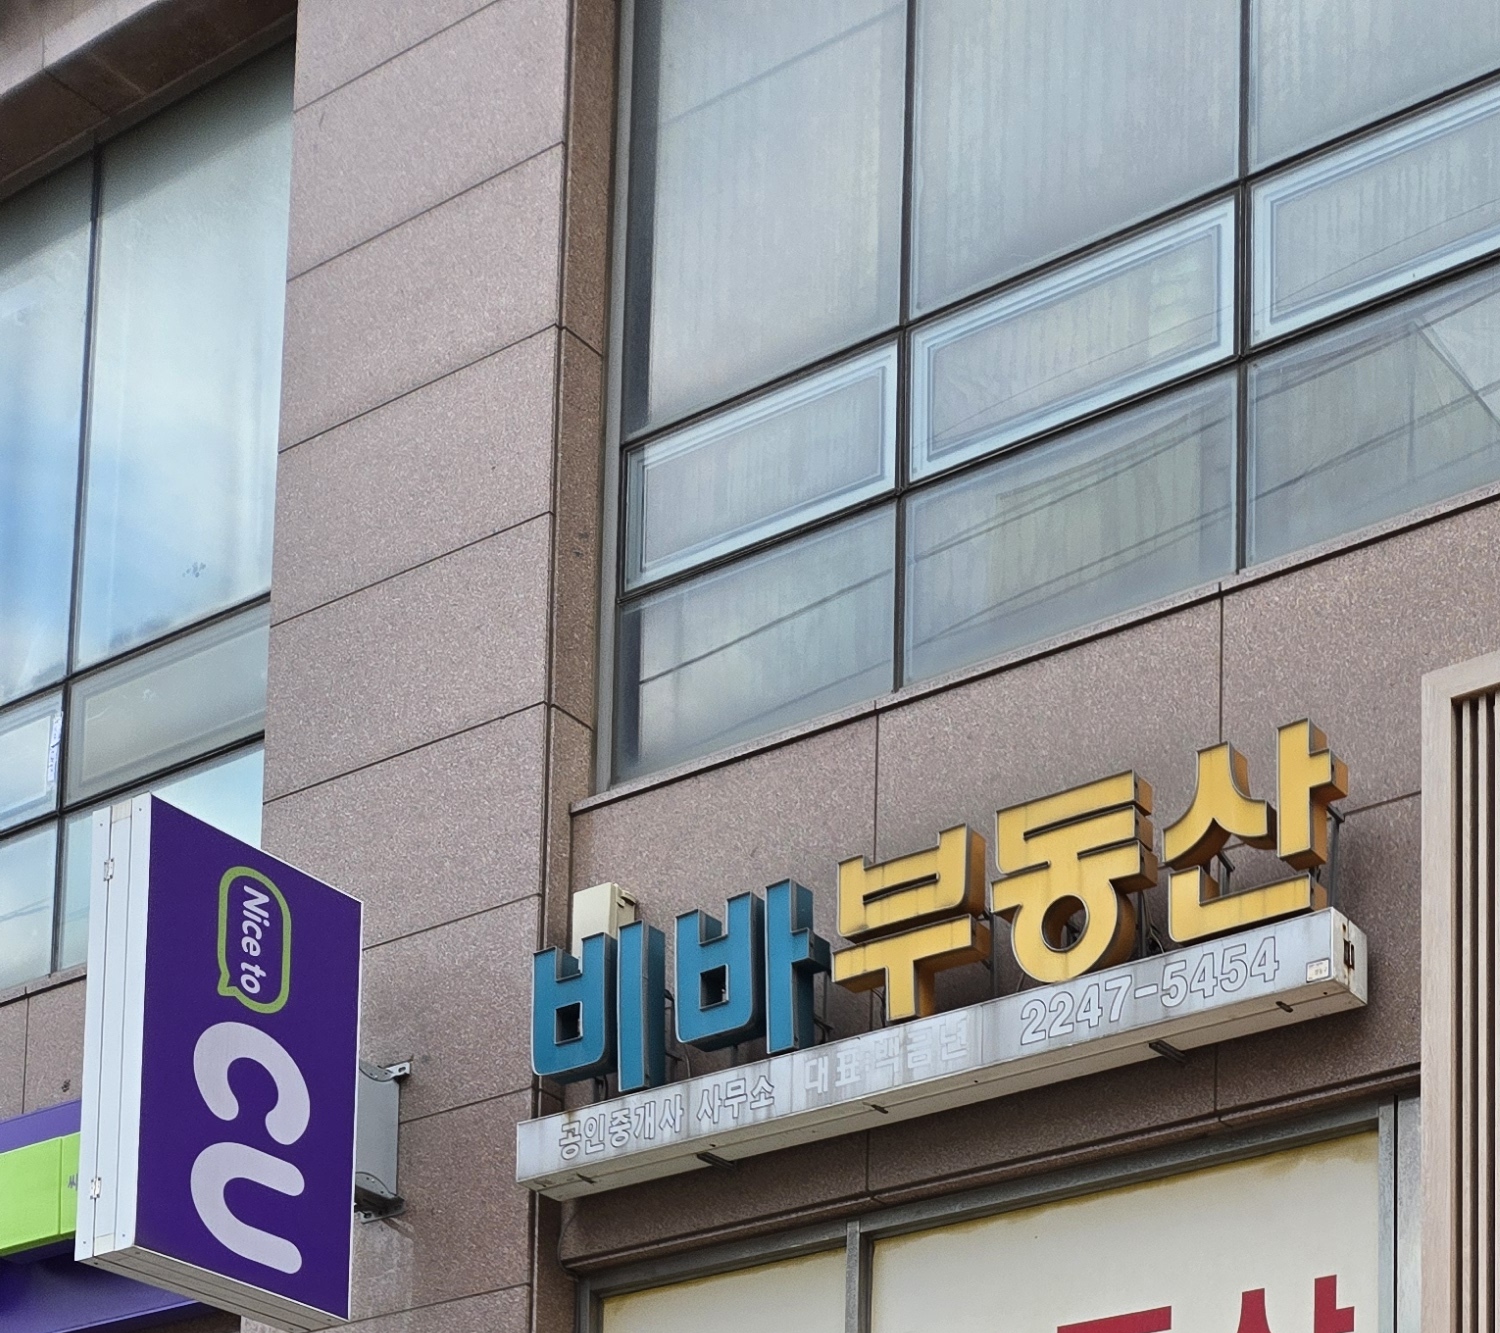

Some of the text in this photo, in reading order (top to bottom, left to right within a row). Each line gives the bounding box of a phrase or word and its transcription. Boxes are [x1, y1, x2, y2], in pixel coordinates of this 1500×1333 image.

[240, 884, 272, 995] Nice to
[531, 718, 1348, 1092] 비바 부동산
[190, 1021, 311, 1275] CU
[559, 1094, 683, 1162] 공인중개사
[697, 1071, 775, 1126] 사무소
[1019, 936, 1281, 1046] 2247-5454
